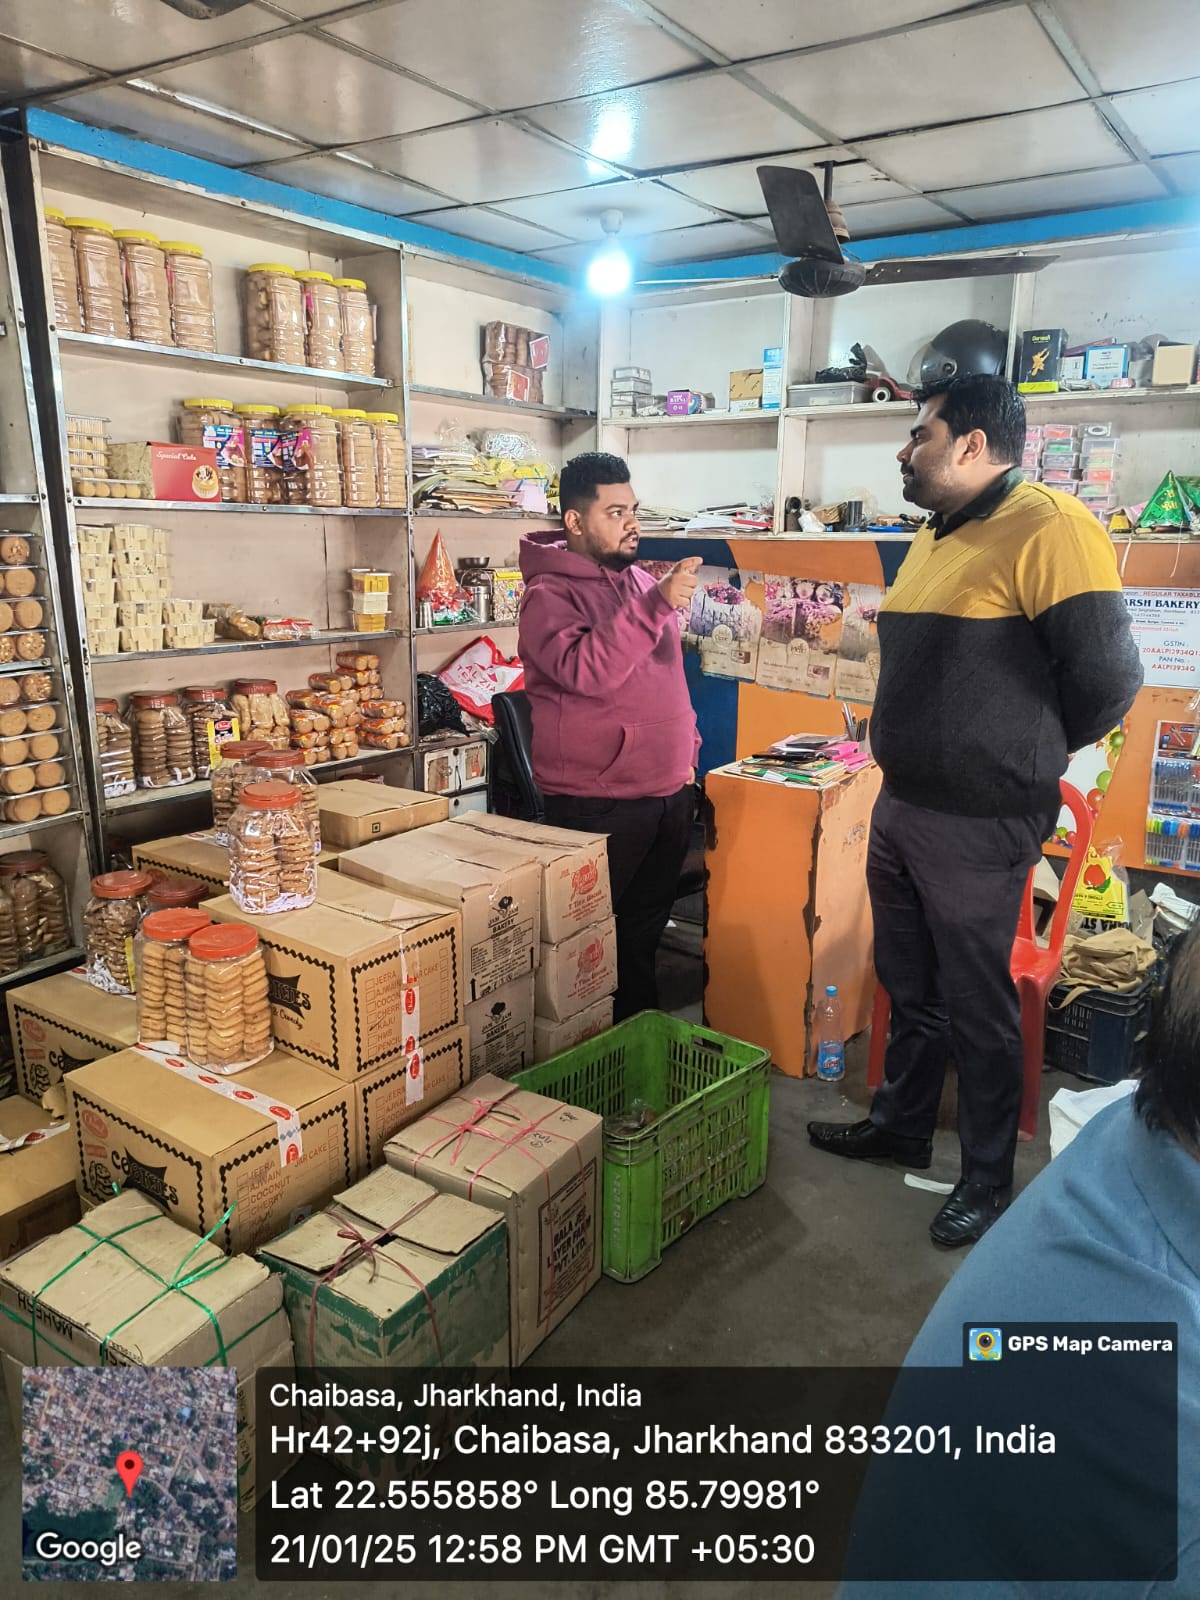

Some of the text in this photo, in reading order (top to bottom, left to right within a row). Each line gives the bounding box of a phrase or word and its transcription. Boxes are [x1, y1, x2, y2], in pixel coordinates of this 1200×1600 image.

[1155, 599, 1200, 609] BAKERY
[492, 919, 515, 934] BAKERY
[375, 970, 397, 986] JEERA
[423, 963, 439, 977] CAKE
[377, 1015, 396, 1031] KAJU
[308, 1143, 328, 1160] CAKE
[248, 1160, 276, 1180] JEERA
[250, 1169, 281, 1192] AJWAIN
[250, 1175, 291, 1204] COCONUT
[250, 1191, 285, 1216] CHERRY
